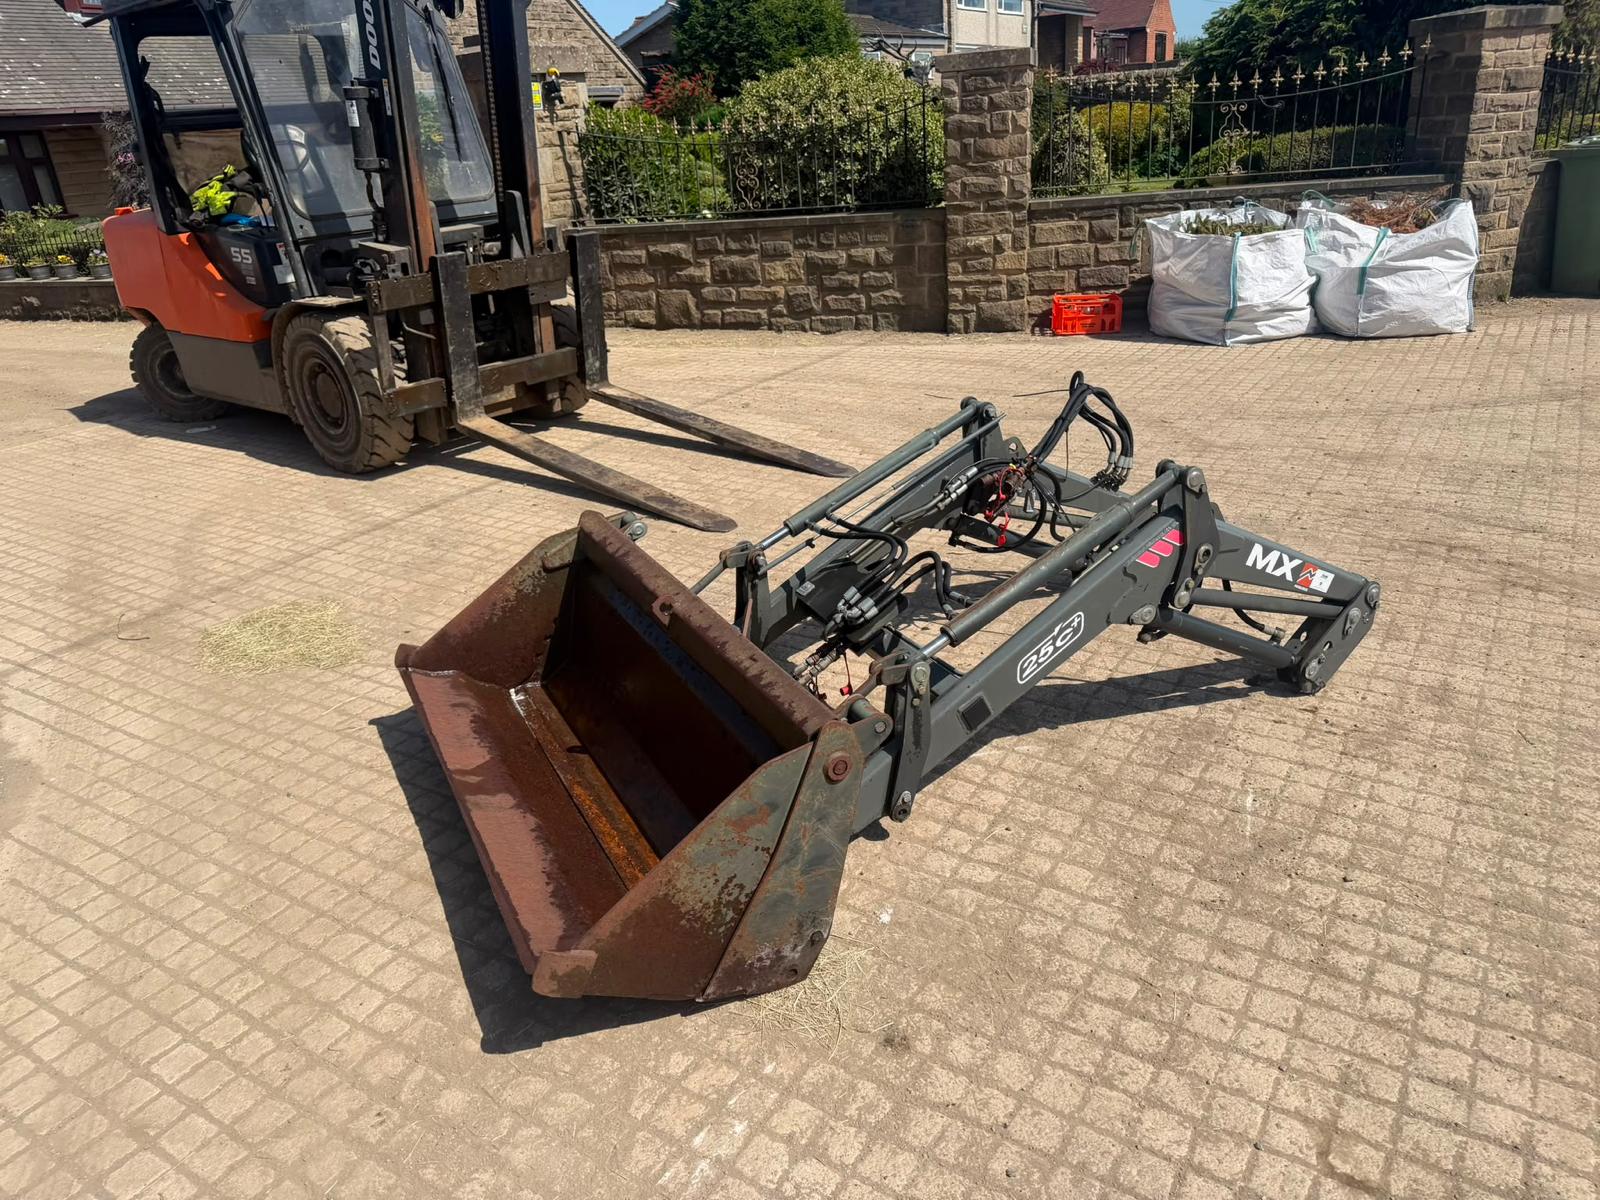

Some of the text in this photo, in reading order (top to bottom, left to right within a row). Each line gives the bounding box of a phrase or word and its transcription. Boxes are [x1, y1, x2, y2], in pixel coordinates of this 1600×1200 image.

[363, 0, 381, 70] DOO
[231, 247, 252, 264] 55
[1245, 543, 1303, 582] MX
